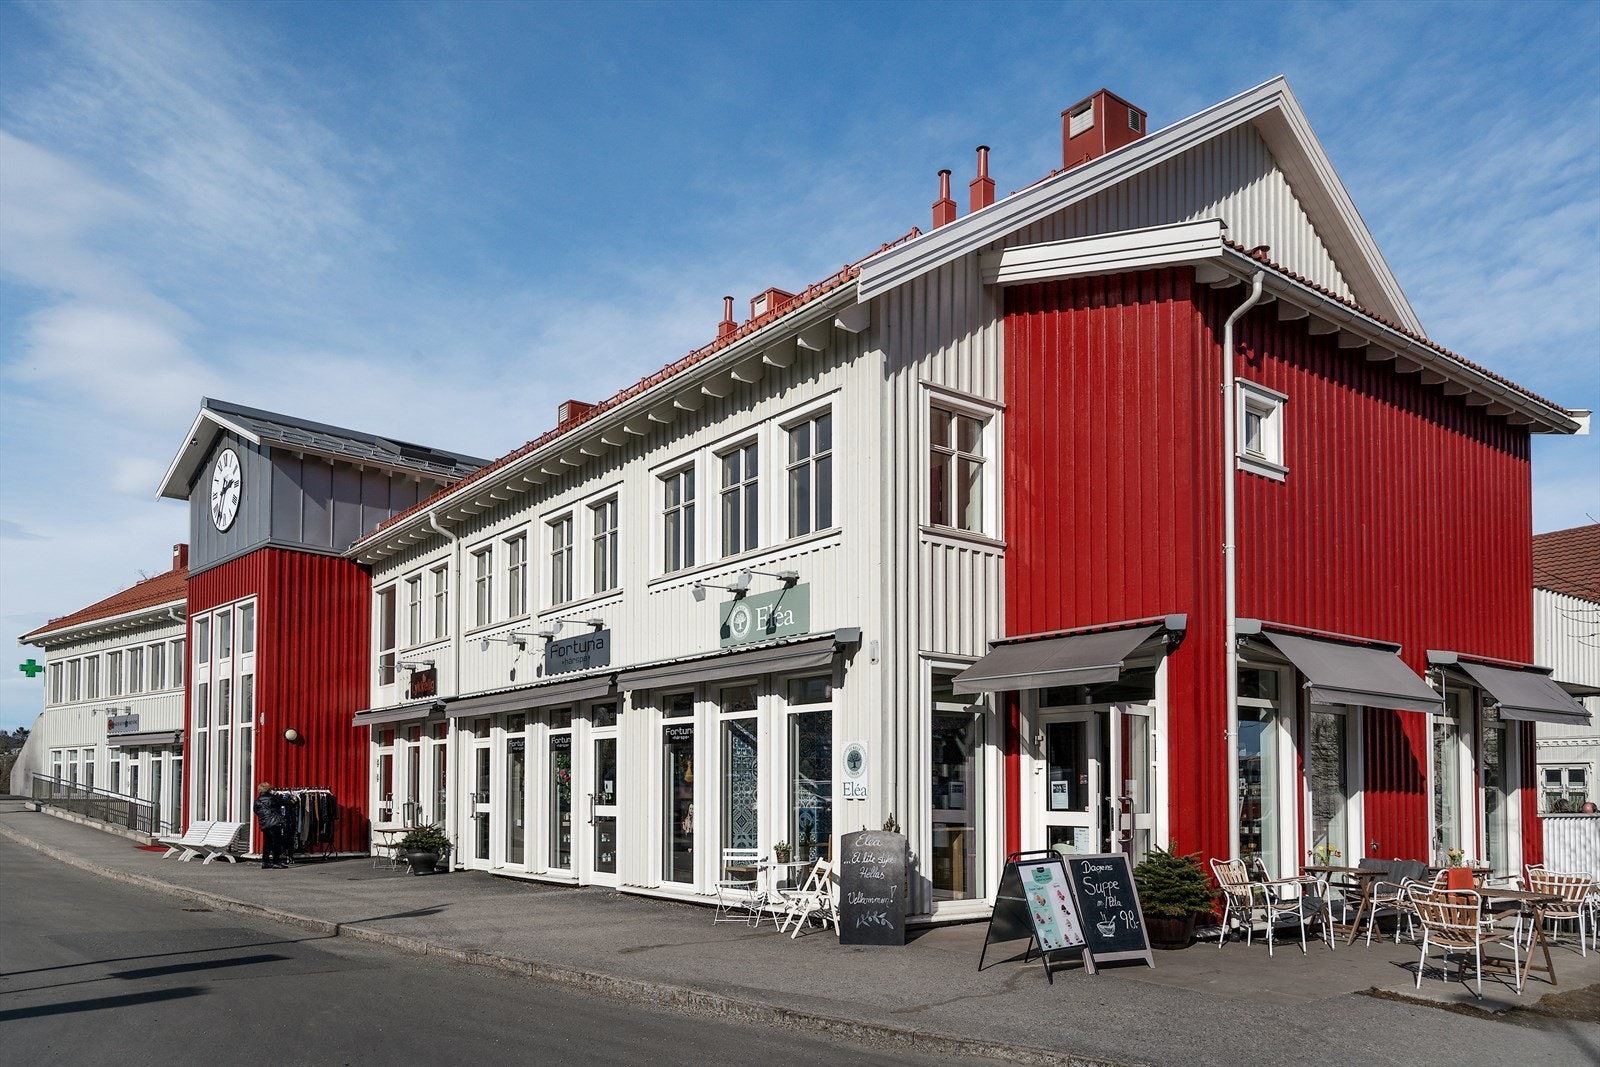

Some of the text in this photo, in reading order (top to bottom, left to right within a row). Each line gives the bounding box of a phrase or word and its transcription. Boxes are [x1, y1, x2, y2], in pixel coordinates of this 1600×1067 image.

[755, 604, 795, 631] Eléa
[550, 638, 604, 660] Fortuna
[842, 781, 868, 797] Eléa
[859, 866, 885, 880] Hellas
[1080, 860, 1113, 875] Dagens
[1082, 876, 1120, 897] Suppe
